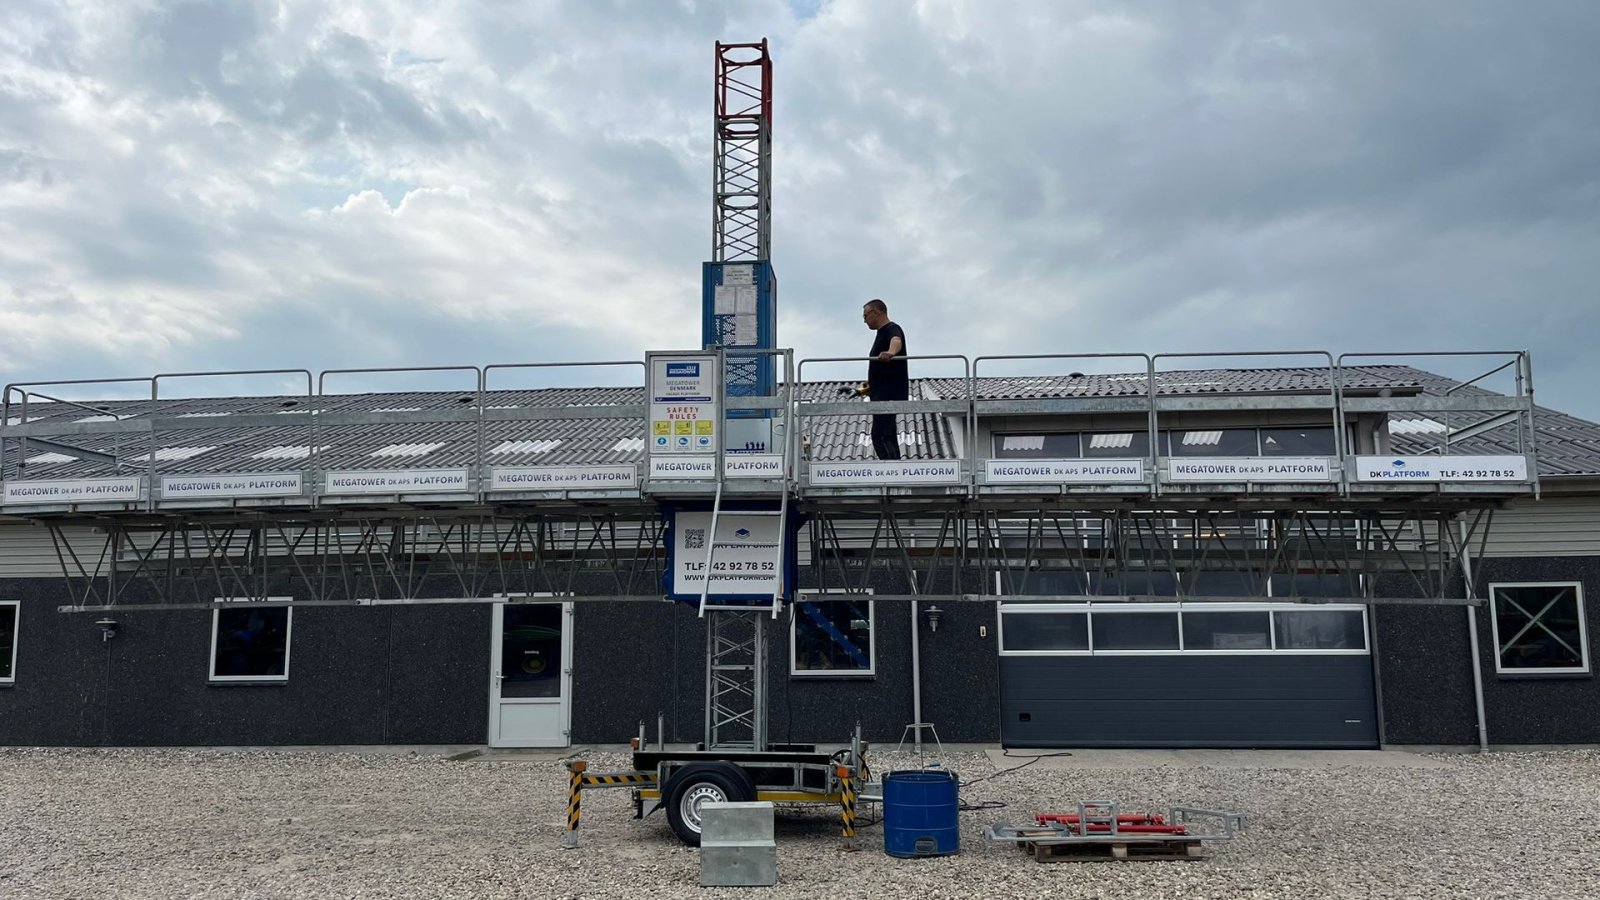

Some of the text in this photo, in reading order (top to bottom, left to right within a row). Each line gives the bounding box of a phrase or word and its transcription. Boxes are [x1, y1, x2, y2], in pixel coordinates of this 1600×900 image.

[656, 463, 712, 471] MEGATOWER
[727, 462, 779, 470] PLATFORM
[1176, 465, 1236, 473] MEGATOWER
[1268, 465, 1324, 473] PLATFORM
[816, 469, 872, 477] MEGATOWER
[993, 467, 1051, 475] MEGATOWER
[1082, 466, 1137, 474] PLATFORM
[332, 478, 386, 486] MEGATOWER
[498, 474, 552, 482] MEGATOWER
[168, 482, 221, 491] MEGATOWER
[249, 480, 297, 488] PLATFORM
[10, 487, 59, 496] MEGATOWER
[86, 485, 134, 494] PLATFORM
[713, 562, 726, 570] 42
[729, 562, 742, 570] 92
[745, 562, 758, 570] 78
[761, 562, 774, 570] 52
